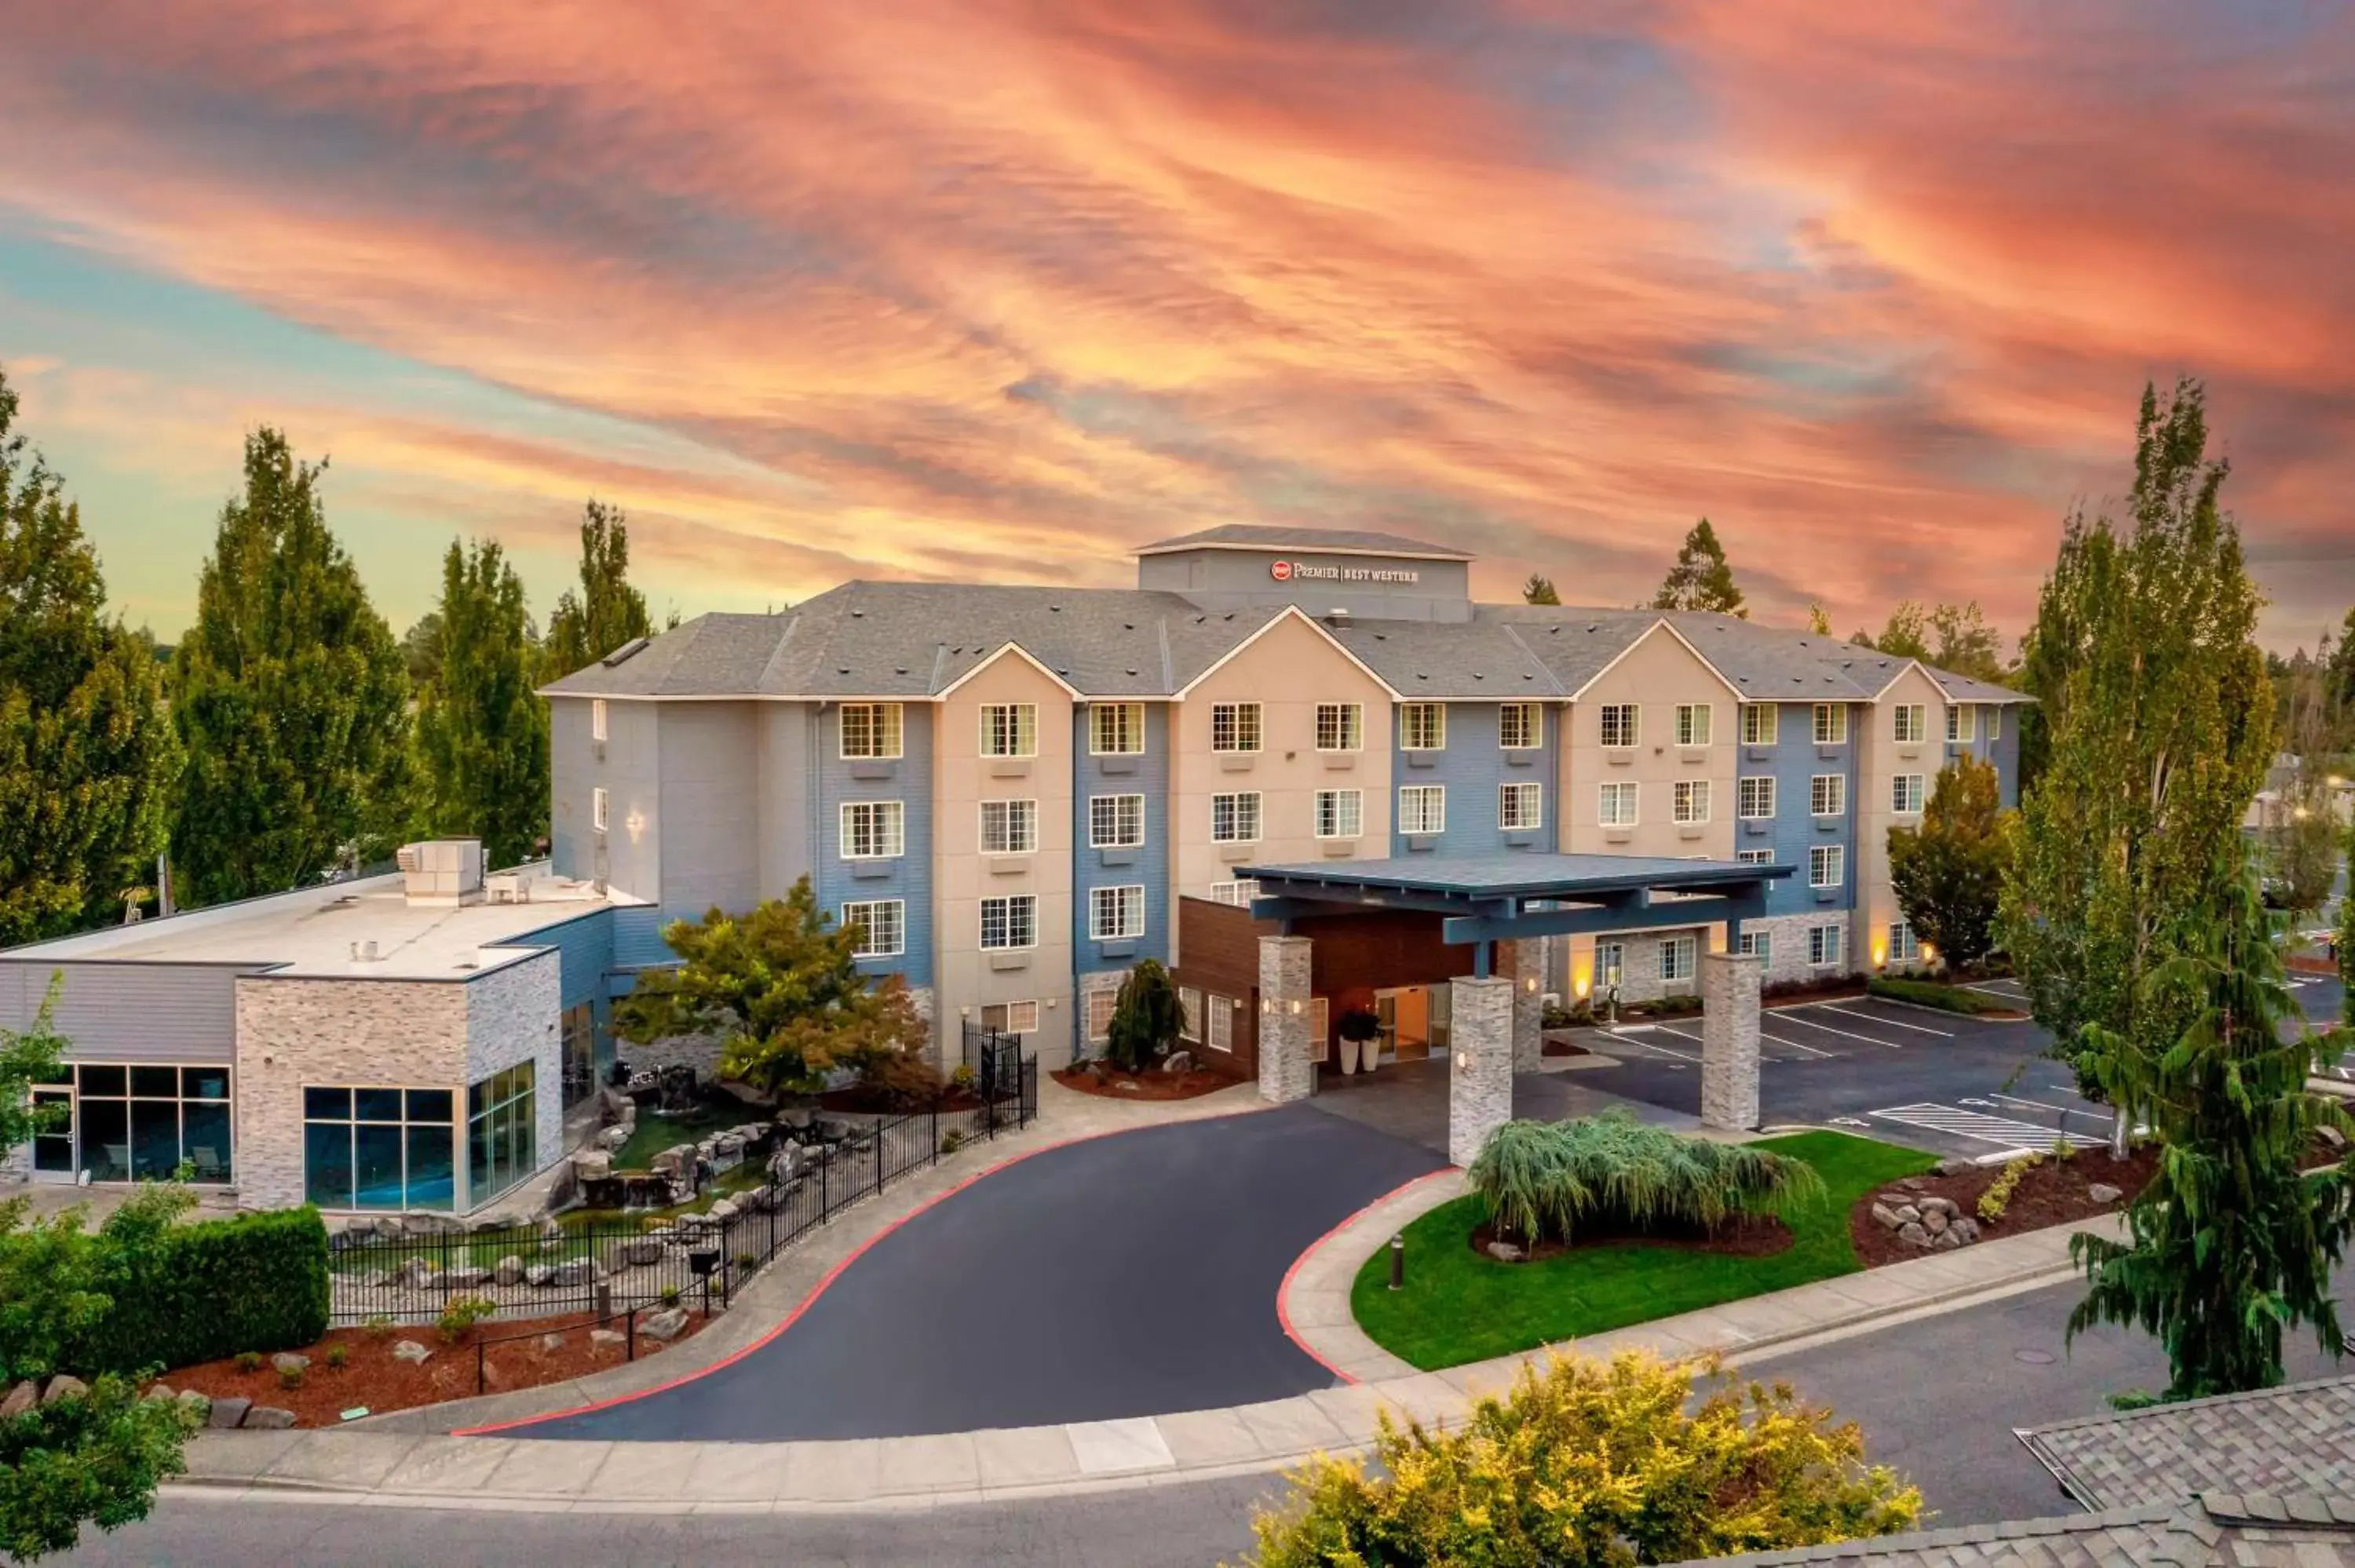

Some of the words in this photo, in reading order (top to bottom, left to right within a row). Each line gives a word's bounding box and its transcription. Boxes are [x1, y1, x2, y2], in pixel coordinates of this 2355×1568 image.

[1294, 563, 1338, 579] PREMIER
[1344, 567, 1369, 580] BEST
[1371, 571, 1418, 582] WESTERN
